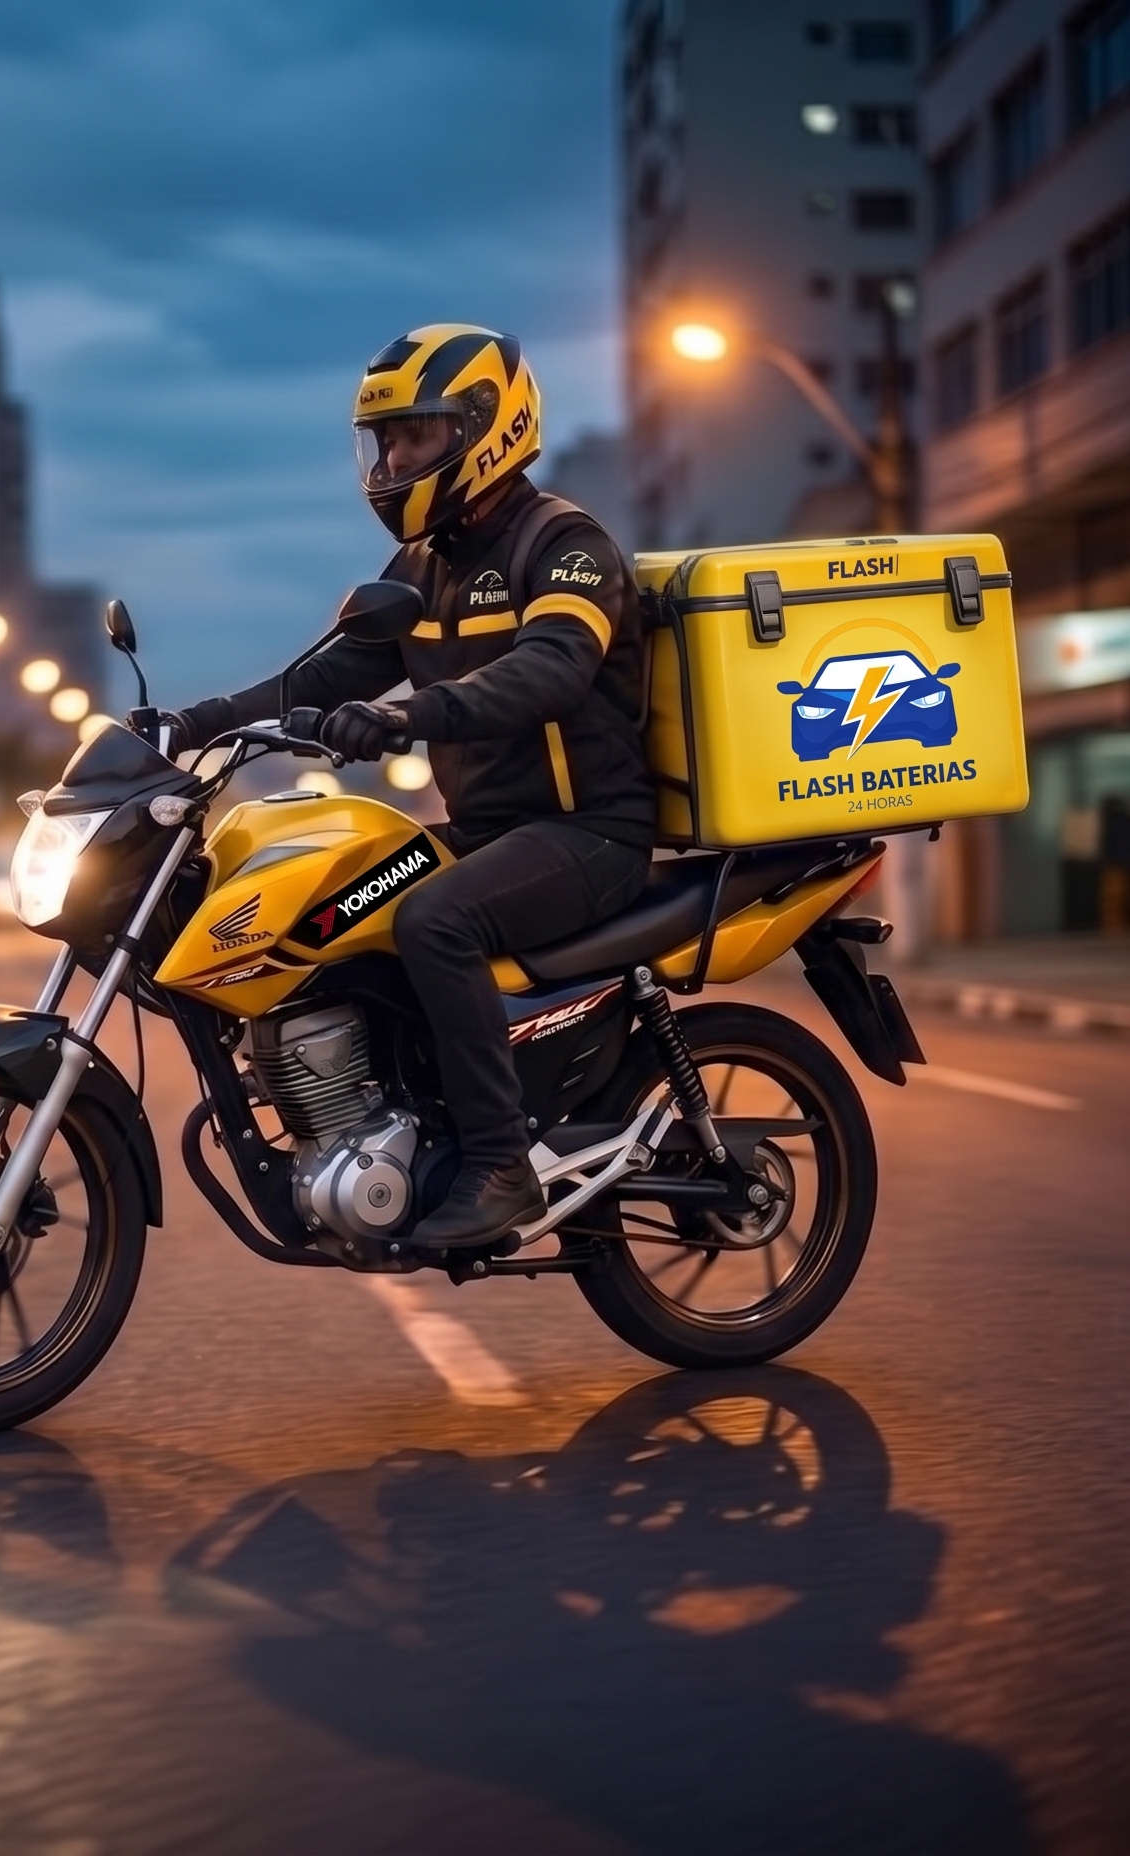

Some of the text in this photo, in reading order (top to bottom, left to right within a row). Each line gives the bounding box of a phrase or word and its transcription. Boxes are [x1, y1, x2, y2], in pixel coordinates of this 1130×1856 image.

[476, 400, 532, 478] FLASH
[828, 556, 894, 580] FLASH
[778, 759, 977, 802] FLASH BATERIAS
[848, 795, 913, 813] 24 HORAS
[337, 850, 430, 917] YOKOHAMA
[212, 931, 275, 953] HONDA
